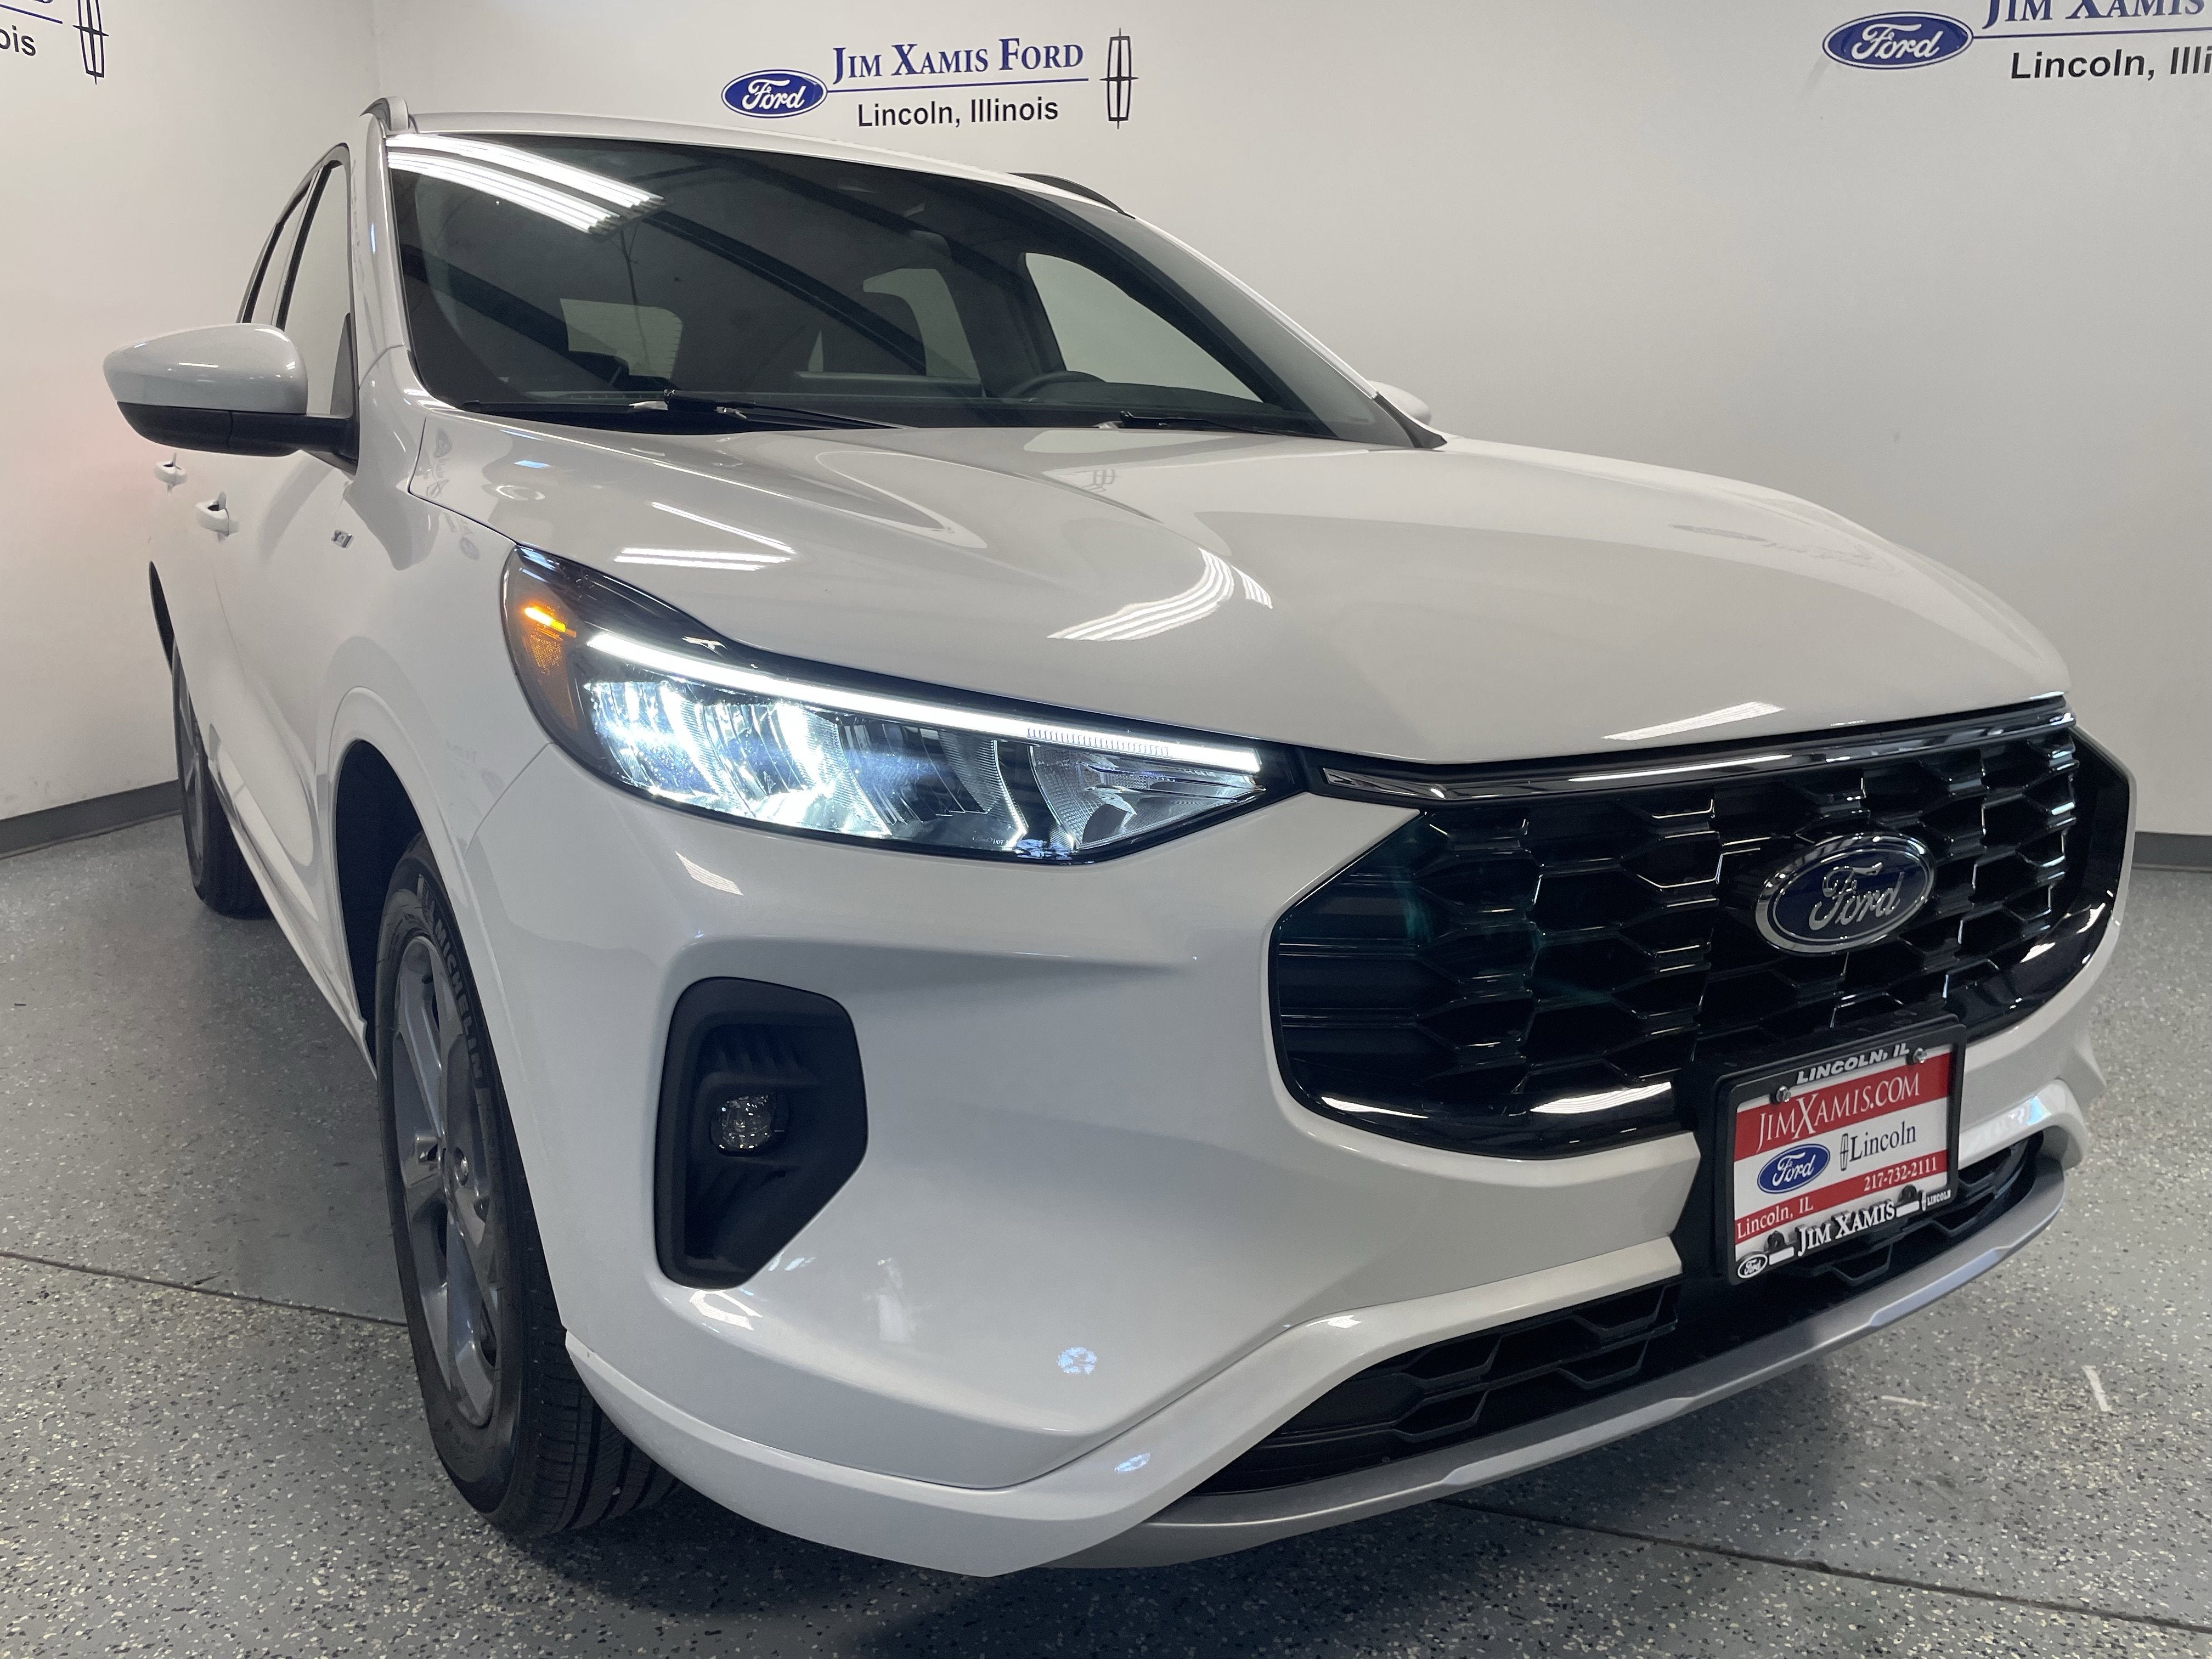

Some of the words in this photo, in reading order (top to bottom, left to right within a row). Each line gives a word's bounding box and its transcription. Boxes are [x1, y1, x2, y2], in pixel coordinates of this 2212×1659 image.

[832, 47, 881, 84] JIM
[891, 44, 988, 77] XAMIS
[999, 38, 1084, 70] FORD
[1851, 23, 1944, 60] Ford
[2011, 48, 2154, 81] Lincoln,
[741, 79, 806, 110] Ford
[858, 100, 960, 127] Lincoln,
[971, 97, 1058, 122] Illinois
[1809, 862, 1904, 930] Ford
[434, 918, 483, 1080] MICHELIN
[1796, 1048, 1888, 1085] LINCOLN,
[1893, 1043, 1909, 1057] IL
[1756, 1072, 1920, 1153] JIMXAMIS.COM
[1849, 1121, 1917, 1162] Lincoln
[1773, 1152, 1816, 1186] Ford
[1864, 1156, 1938, 1192] 217-732-2111
[1737, 1205, 1793, 1239] Lincoln,
[1799, 1197, 1814, 1215] IL
[1798, 1224, 1831, 1256] JIM
[1835, 1201, 1896, 1239] XAMIS
[1744, 1259, 1762, 1276] Ford
